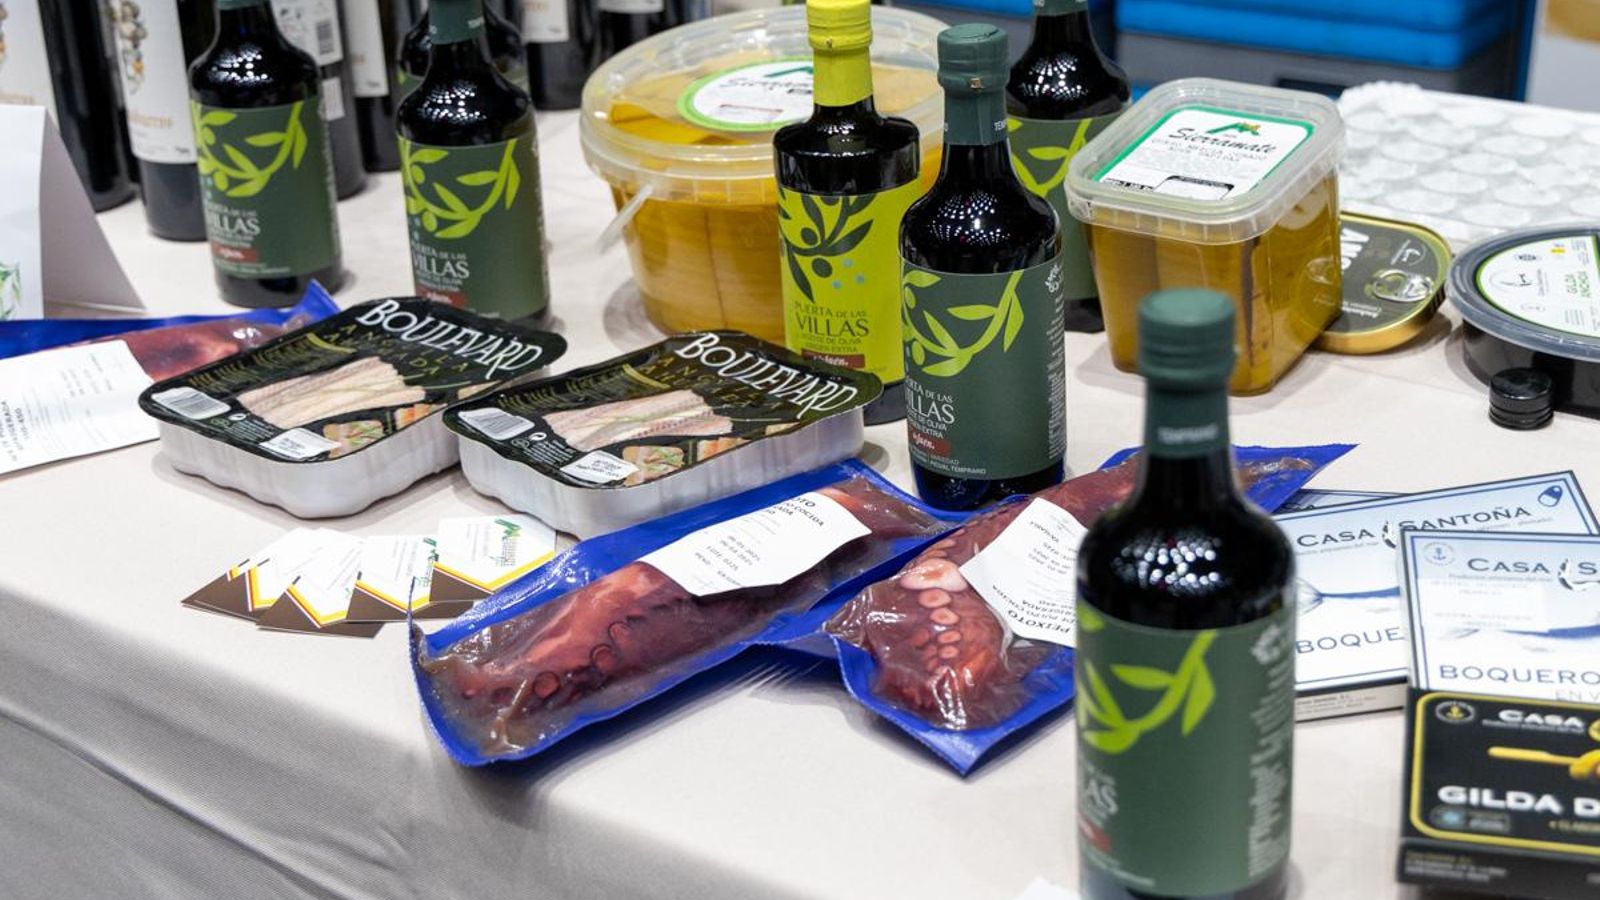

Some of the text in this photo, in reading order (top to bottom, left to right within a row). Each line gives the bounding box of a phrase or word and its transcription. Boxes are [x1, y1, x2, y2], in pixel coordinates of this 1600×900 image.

[794, 312, 870, 338] VILLAS
[356, 299, 543, 380] BOULEVARD
[674, 332, 858, 419] BOULEVARD
[1296, 506, 1532, 548] CASA SANTOÑA
[1467, 557, 1552, 575] CASA
[1007, 608, 1071, 634] PEIXOTO
[1296, 627, 1405, 655] BOQUE
[1498, 709, 1585, 728] CASA
[1437, 785, 1563, 816] GILDA
